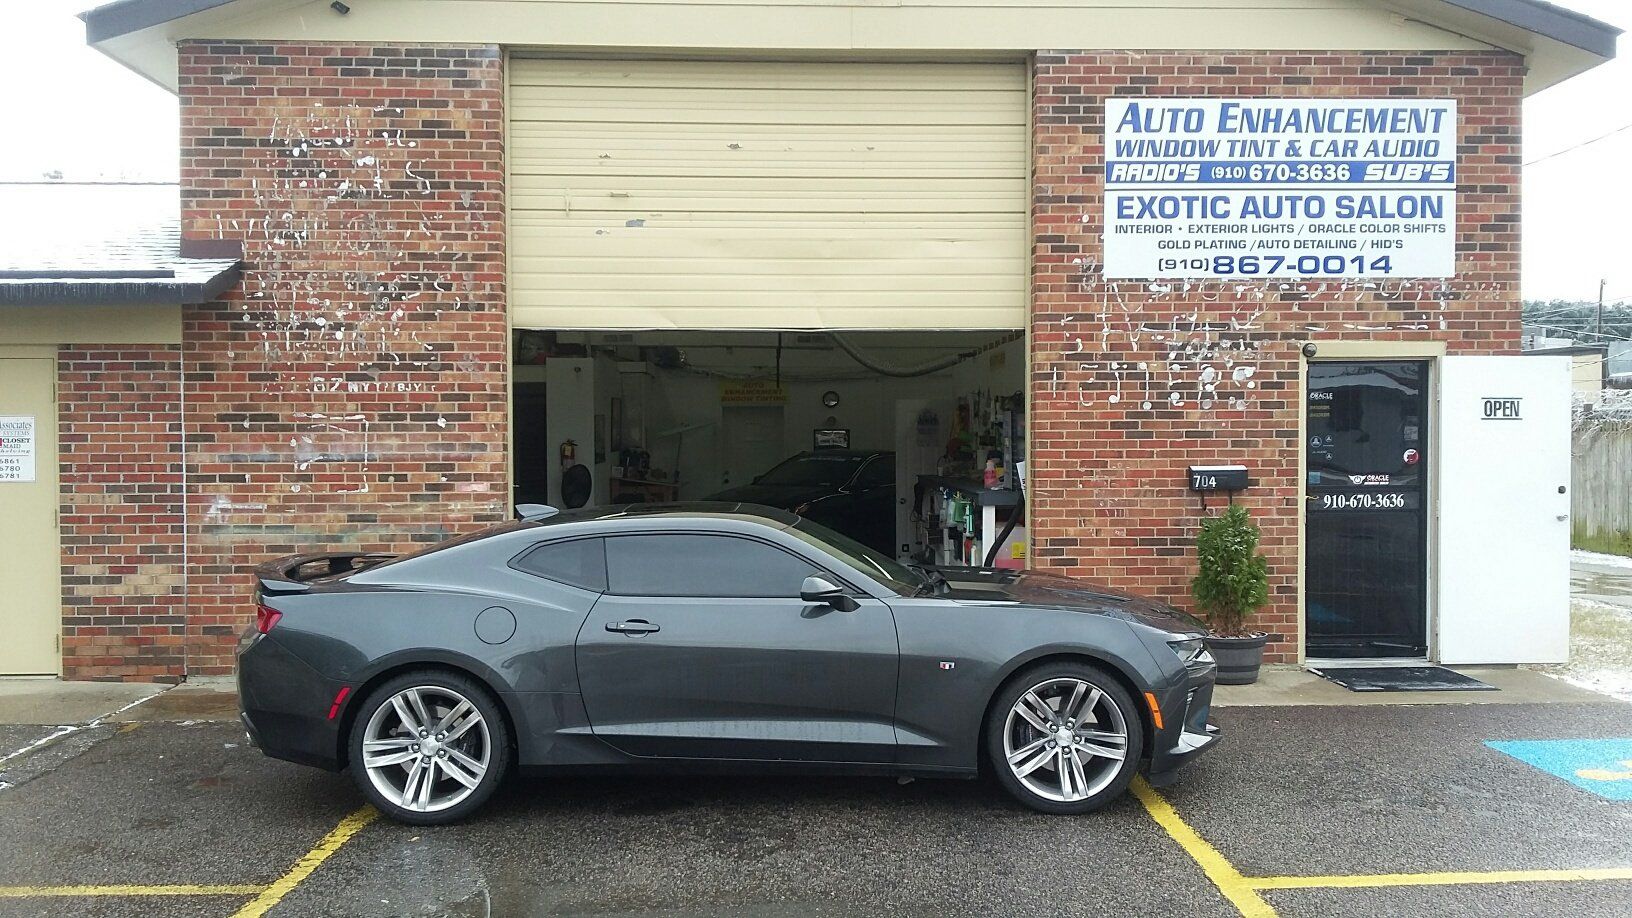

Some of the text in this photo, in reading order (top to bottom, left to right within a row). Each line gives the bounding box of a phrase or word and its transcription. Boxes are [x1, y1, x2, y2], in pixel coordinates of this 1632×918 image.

[1115, 139, 1440, 158] WINDOW TINT & CAR AUDIO
[1110, 163, 1451, 182] RADIO'S (910) 670-3636 SUB'S
[1116, 195, 1444, 220] EXOTIC AUTO SALON
[1115, 224, 1173, 234] INTERIOR
[1188, 224, 1248, 234] EXTERIOR
[1251, 224, 1295, 234] LIGHTS
[1308, 224, 1357, 234] ORACLE
[1359, 224, 1400, 234] COLOR
[1403, 223, 1446, 234] SHIFTS
[1157, 240, 1191, 250] GOLD
[1194, 239, 1247, 250] PLATING
[1293, 239, 1357, 249] DETAILING
[1370, 239, 1404, 249] HID'S
[1212, 255, 1393, 275] 867-0014
[1309, 392, 1333, 400] ORACLE
[1484, 400, 1520, 417] OPEN
[1193, 475, 1217, 488] 704
[1366, 474, 1390, 482] ORACLE
[1323, 493, 1405, 509] 910-670-3636
